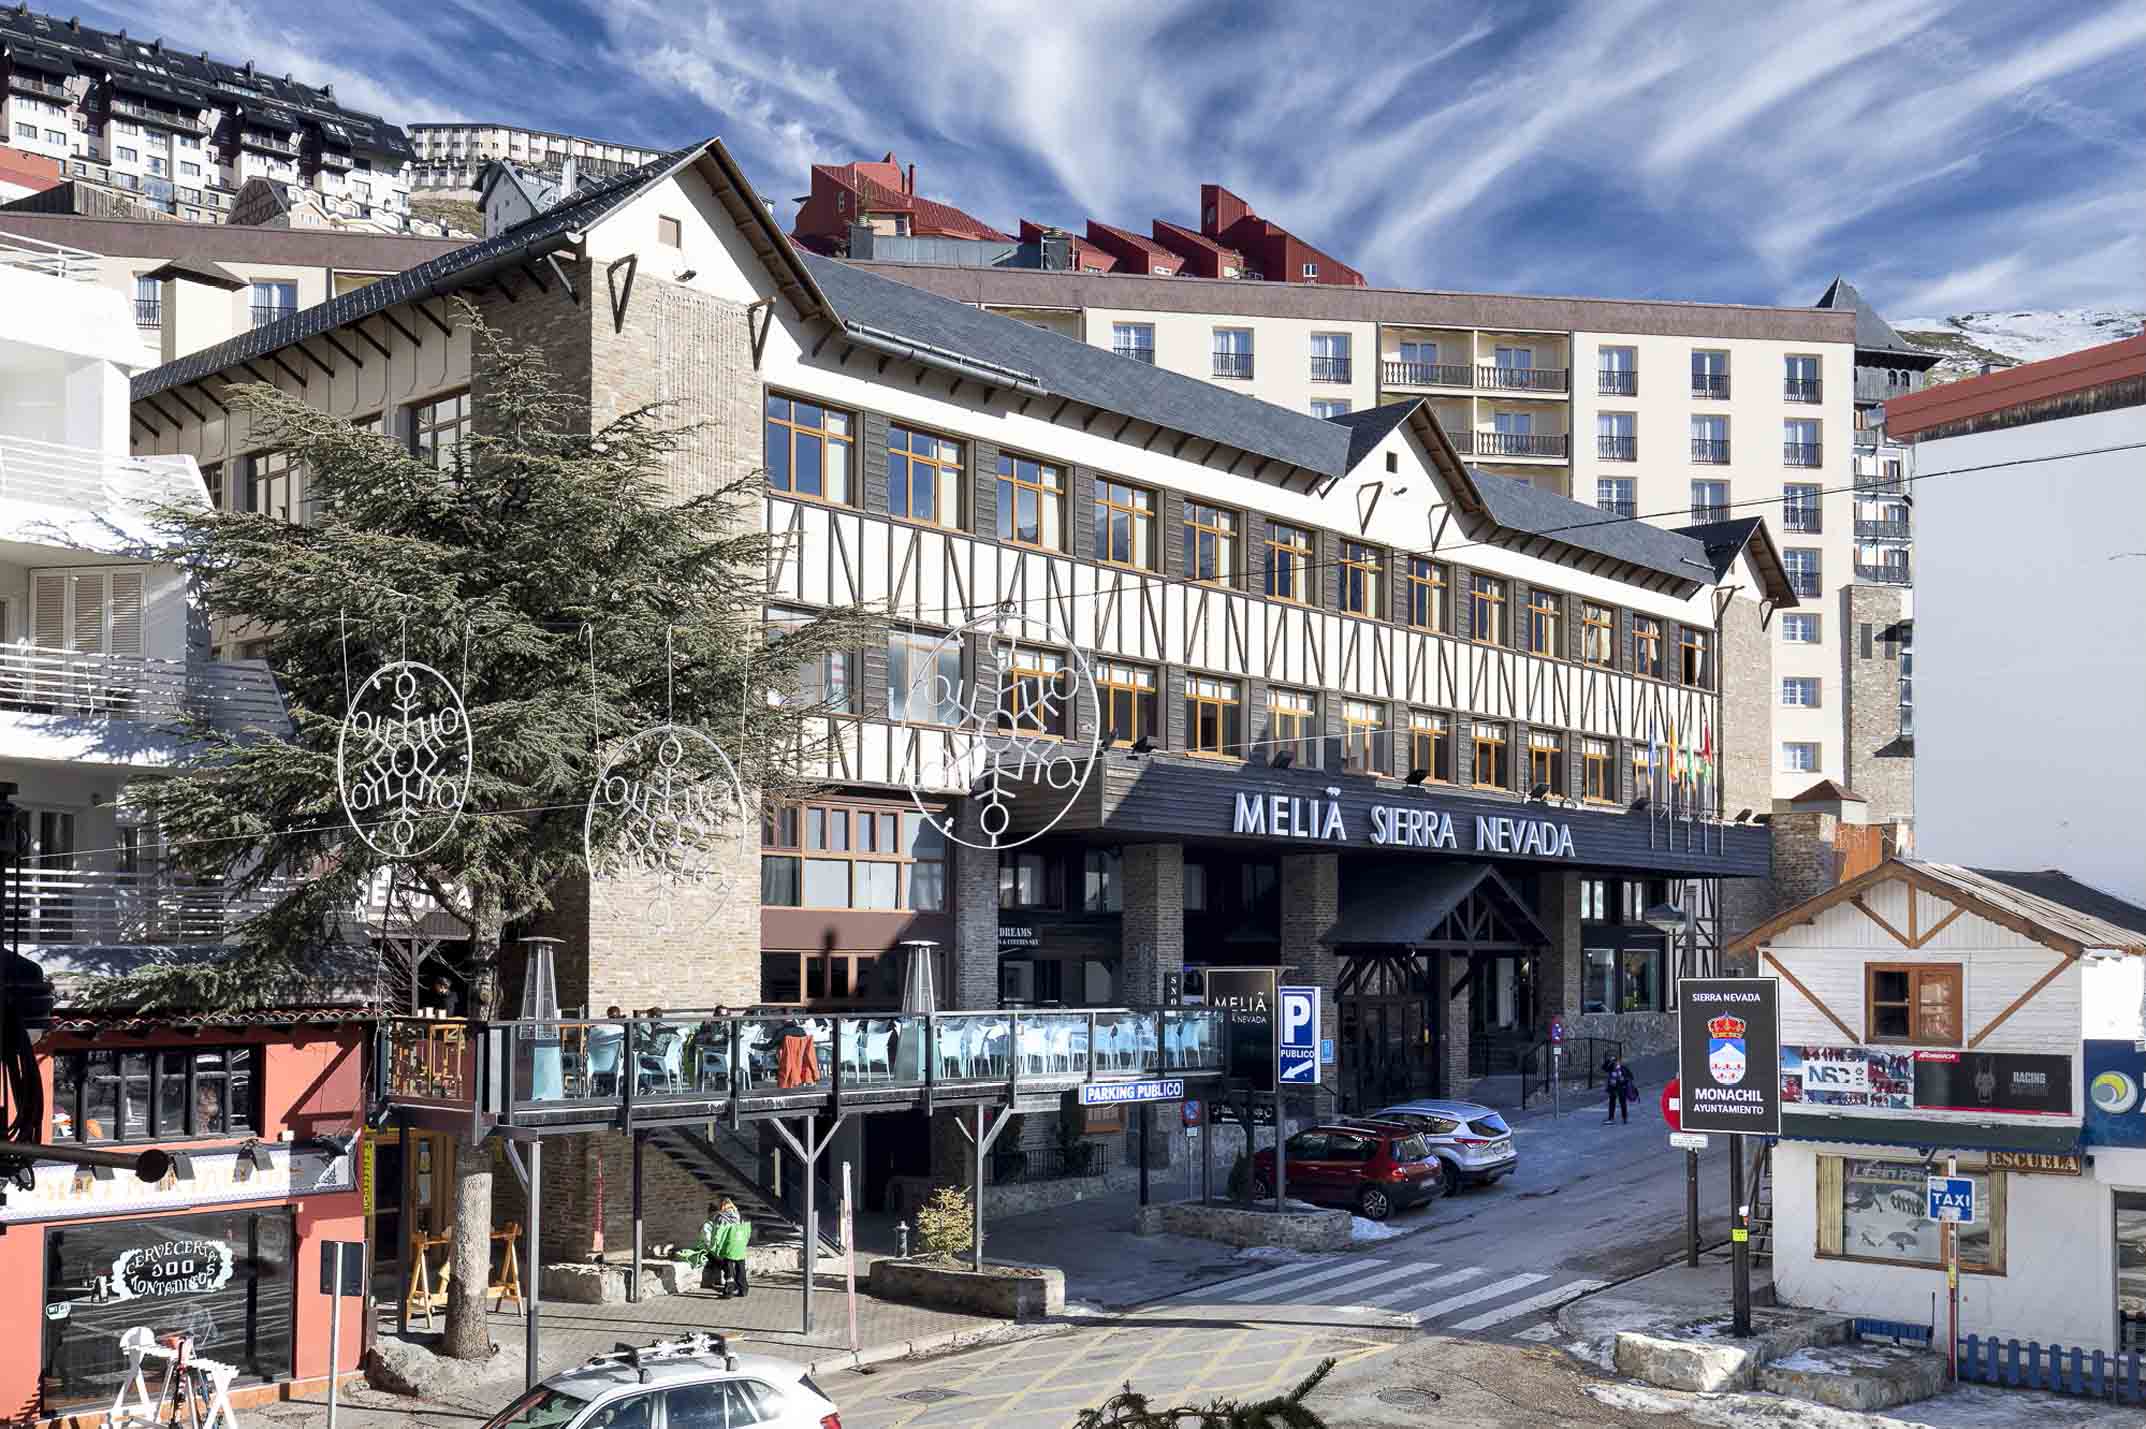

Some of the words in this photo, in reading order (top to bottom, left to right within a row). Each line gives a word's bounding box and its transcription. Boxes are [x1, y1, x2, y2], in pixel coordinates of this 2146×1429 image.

[1369, 804, 1458, 848] SIERRA
[1475, 815, 1576, 857] NEVADA
[1692, 993, 1722, 1002] SIERRA
[1723, 993, 1761, 1002] NEVADA
[1284, 995, 1312, 1044] P
[2013, 1071, 2047, 1084] RACING
[1087, 1086, 1136, 1101] PARKING
[1136, 1082, 1181, 1098] PUBLICO
[1695, 1088, 1764, 1102] MONACHIL
[1693, 1104, 1764, 1115] AYUNTAMIENTO
[1991, 1151, 2077, 1169] ESCUELA
[1932, 1192, 1970, 1207] TAXI
